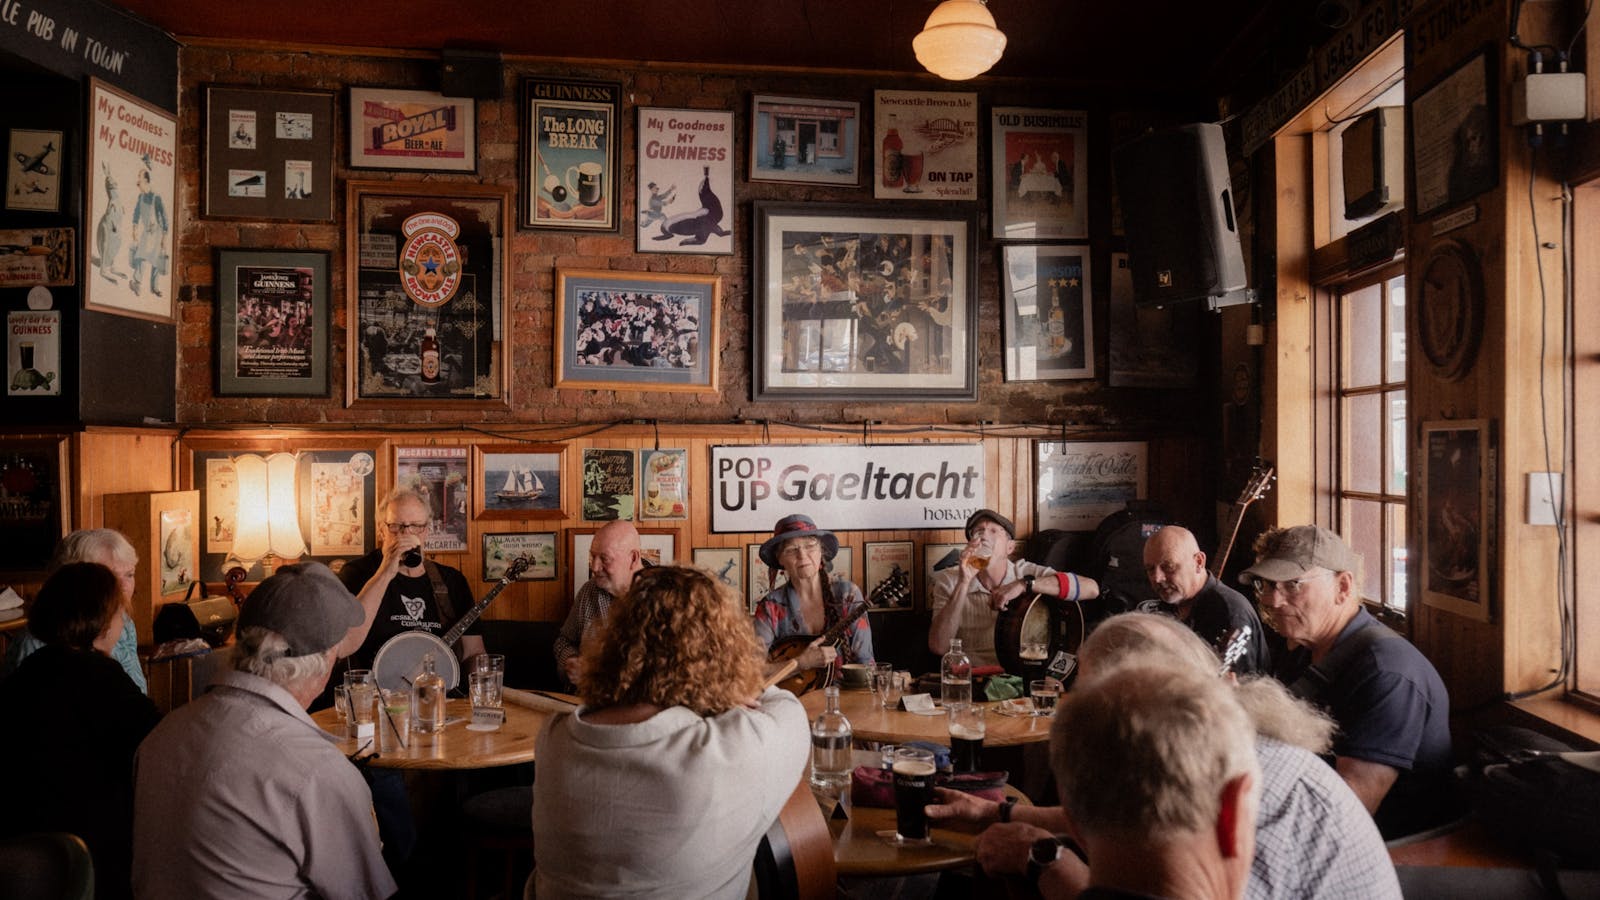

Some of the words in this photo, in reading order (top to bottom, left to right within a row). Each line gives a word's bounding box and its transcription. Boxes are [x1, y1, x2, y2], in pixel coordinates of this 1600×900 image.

[27, 10, 56, 41] PUB
[61, 27, 79, 54] IN
[535, 83, 611, 101] GUINNESS
[880, 96, 925, 106] Newcastle
[926, 98, 955, 108] Brown
[956, 98, 972, 108] Ale
[99, 96, 116, 120] My
[383, 109, 448, 144] ROYAL
[543, 115, 566, 134] The
[567, 117, 604, 135] LONG
[648, 118, 663, 132] My
[669, 118, 725, 132] Goodness
[100, 125, 116, 149] My
[119, 129, 174, 167] GUINNESS
[405, 139, 424, 149] BEER
[430, 140, 443, 150] ALE
[548, 132, 599, 150] BREAK
[678, 133, 695, 143] MY
[646, 140, 727, 161] GUINNESS
[928, 172, 946, 182] ON
[949, 172, 973, 183] TAP
[408, 235, 454, 259] NEWCASTLE
[253, 281, 297, 289] GUINNESS
[408, 278, 441, 300] BROWN
[441, 278, 455, 295] ALE
[13, 326, 53, 335] GUINNESS
[719, 458, 771, 478] POP
[777, 461, 980, 503] Gaeltacht
[720, 480, 771, 511] UP
